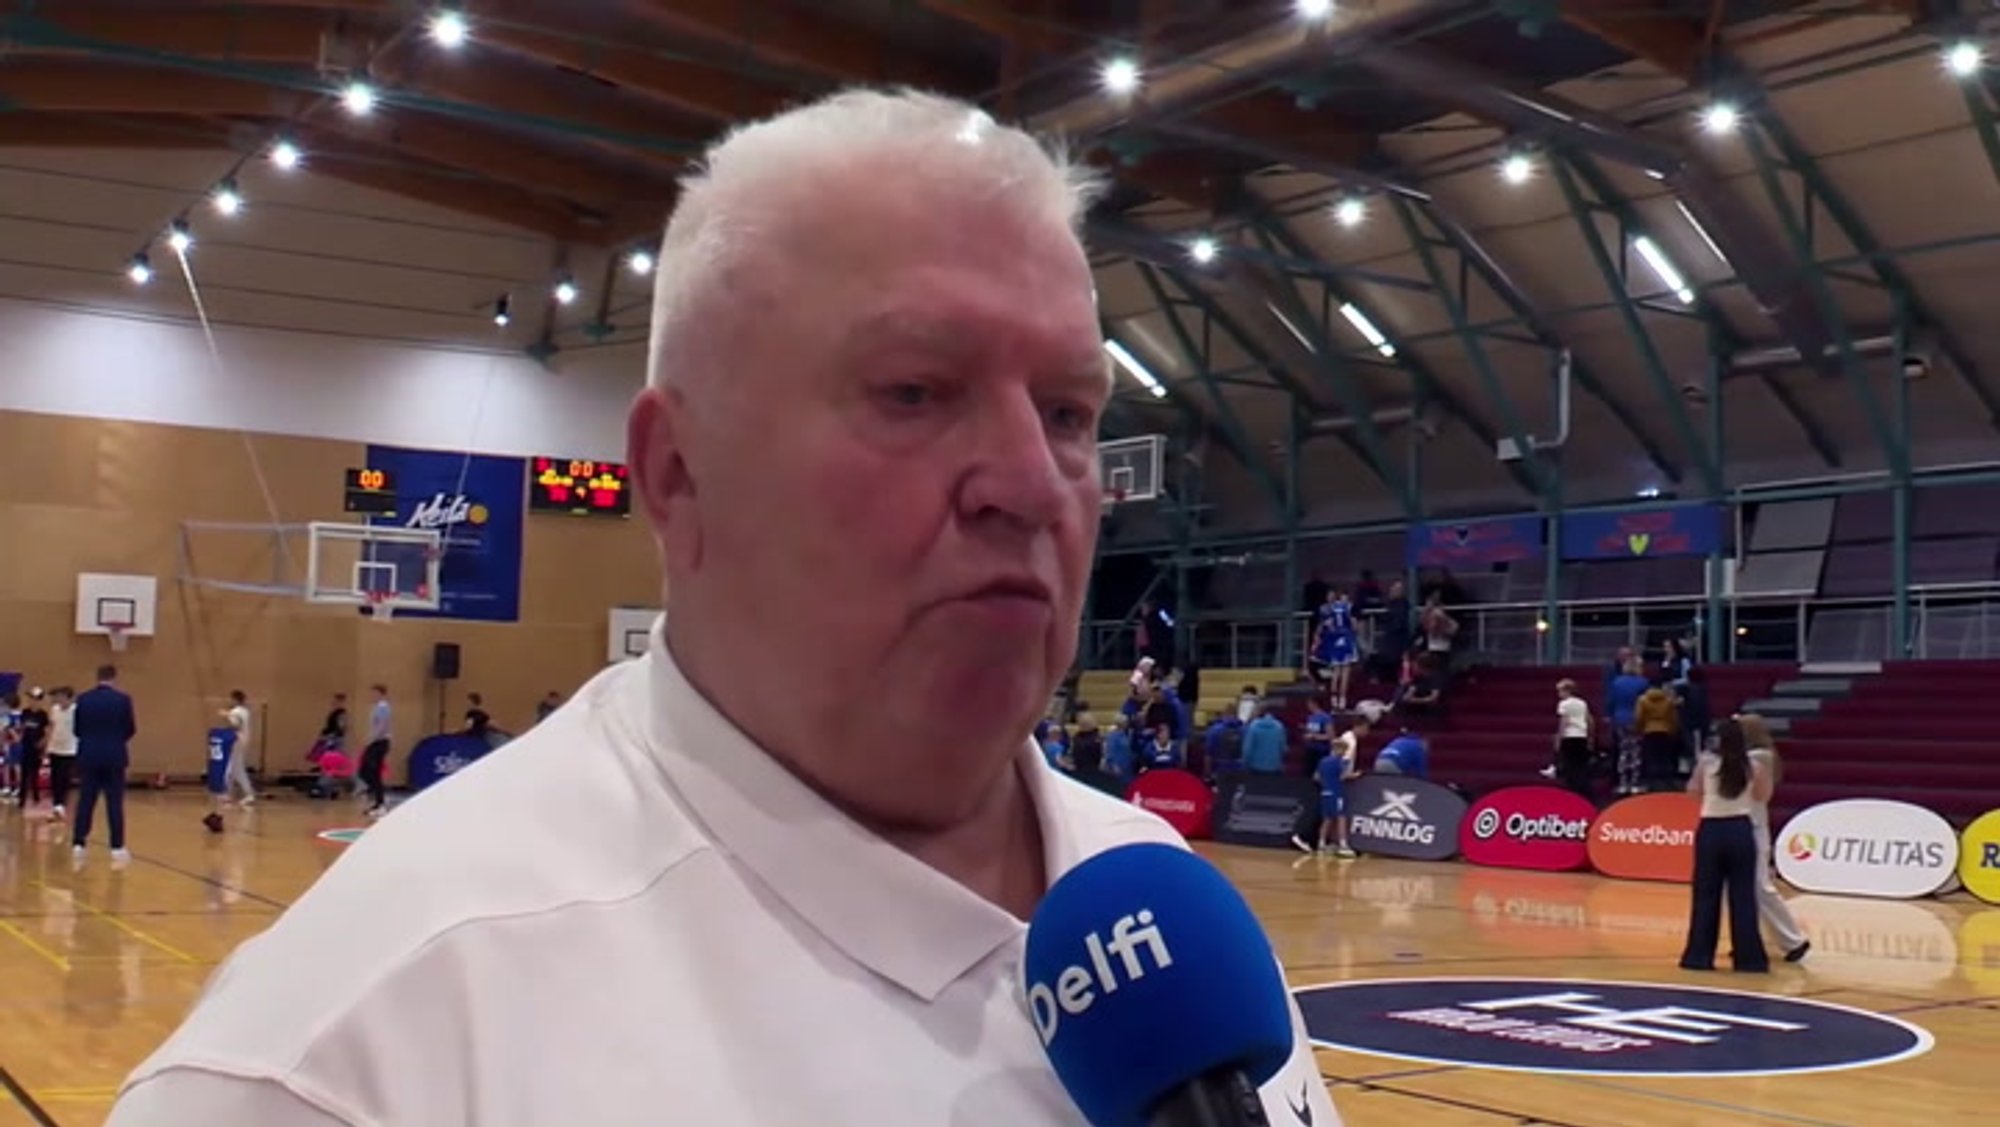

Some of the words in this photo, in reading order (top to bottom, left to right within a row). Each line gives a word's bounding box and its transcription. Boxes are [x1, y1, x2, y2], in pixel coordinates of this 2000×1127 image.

[405, 492, 471, 528] Keila
[1350, 815, 1436, 845] FINNLOG
[1506, 812, 1589, 841] Optibet
[1599, 822, 1694, 846] Swedban
[1821, 836, 1943, 868] UTILITAS
[1029, 908, 1174, 1047] Delfi
